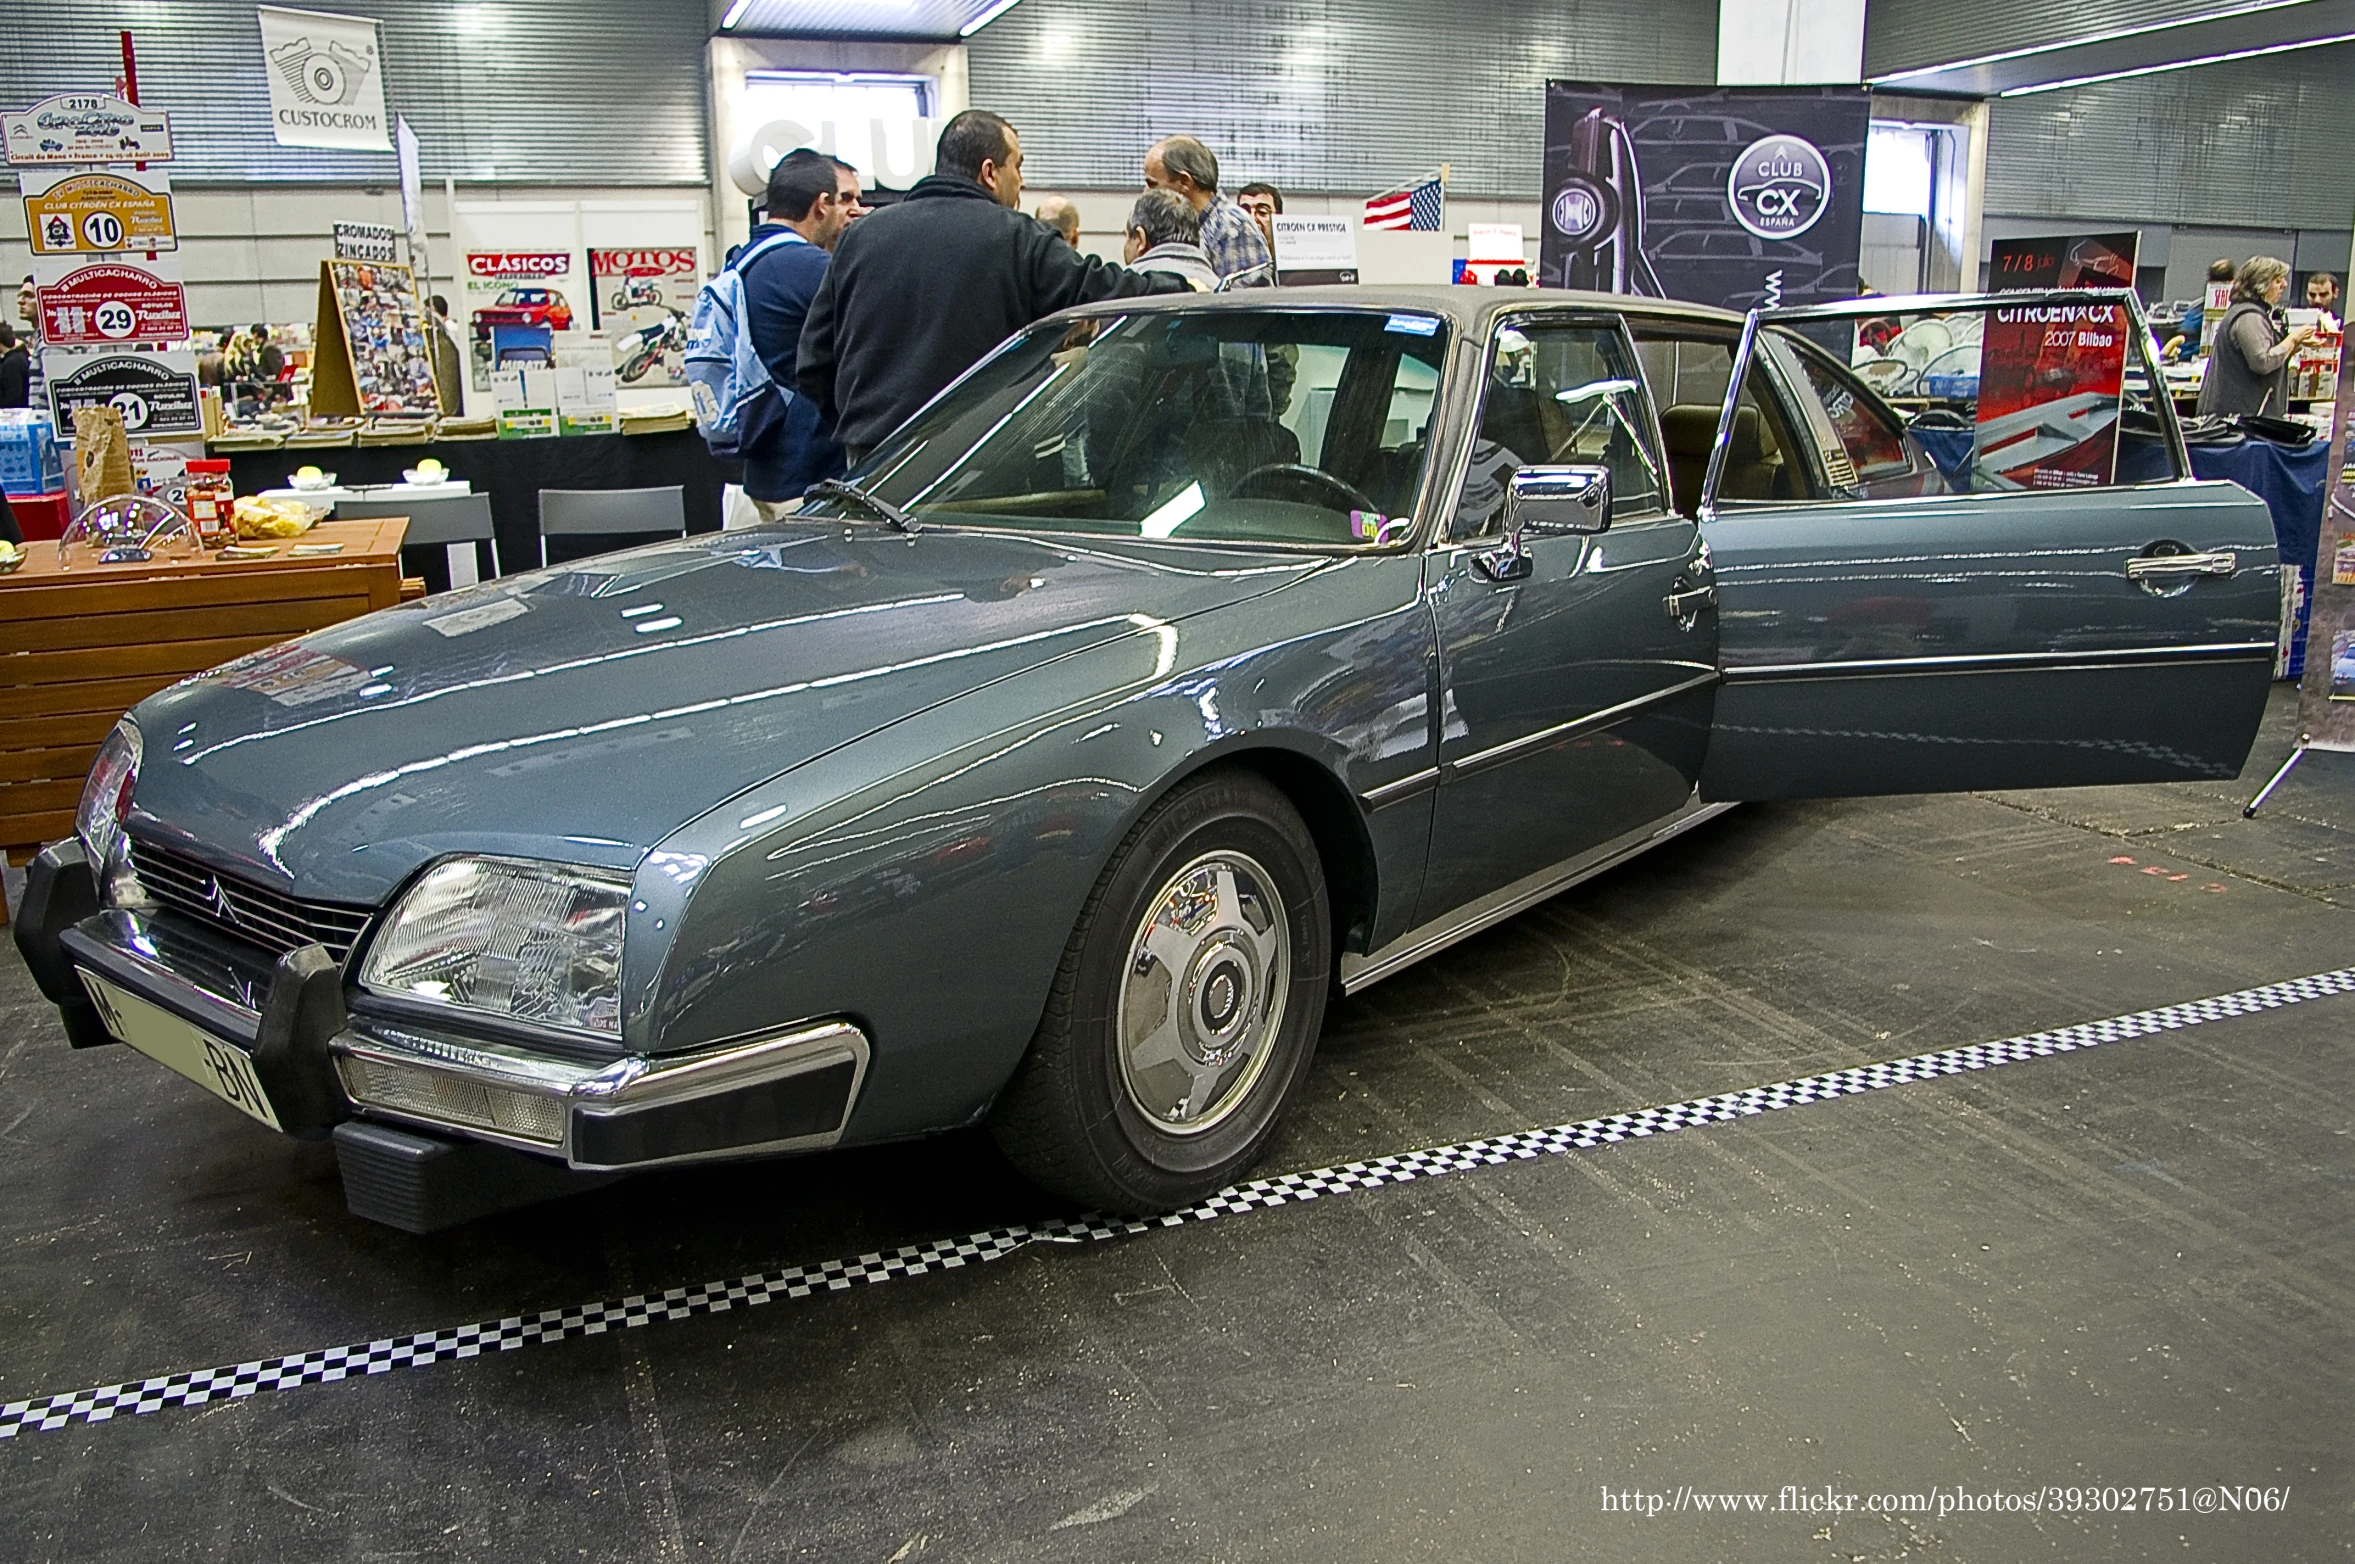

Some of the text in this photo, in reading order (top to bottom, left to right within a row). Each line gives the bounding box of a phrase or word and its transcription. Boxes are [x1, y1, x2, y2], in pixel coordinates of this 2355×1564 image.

[279, 109, 377, 130] CUSTOCROM
[729, 118, 944, 195] CLU
[1758, 161, 1803, 177] CLUB
[44, 202, 68, 210] CLUB
[108, 200, 121, 208] CX
[122, 199, 155, 208] ESPAÑA
[1756, 188, 1801, 216] CX
[89, 217, 119, 243] 10
[1759, 216, 1795, 227] ESPAÑA
[336, 223, 392, 241] CROMADOS
[337, 243, 394, 260] ZINCADOS
[470, 254, 567, 273] CLÁSICOS
[590, 249, 696, 277] MOTOS
[68, 269, 158, 290] MULTICACHARRO
[100, 309, 131, 329] 29
[2088, 305, 2114, 323] CX
[2045, 331, 2113, 347] 2007 Bilbao
[81, 361, 170, 380] MULTICACHARRO
[112, 401, 141, 421] 21
